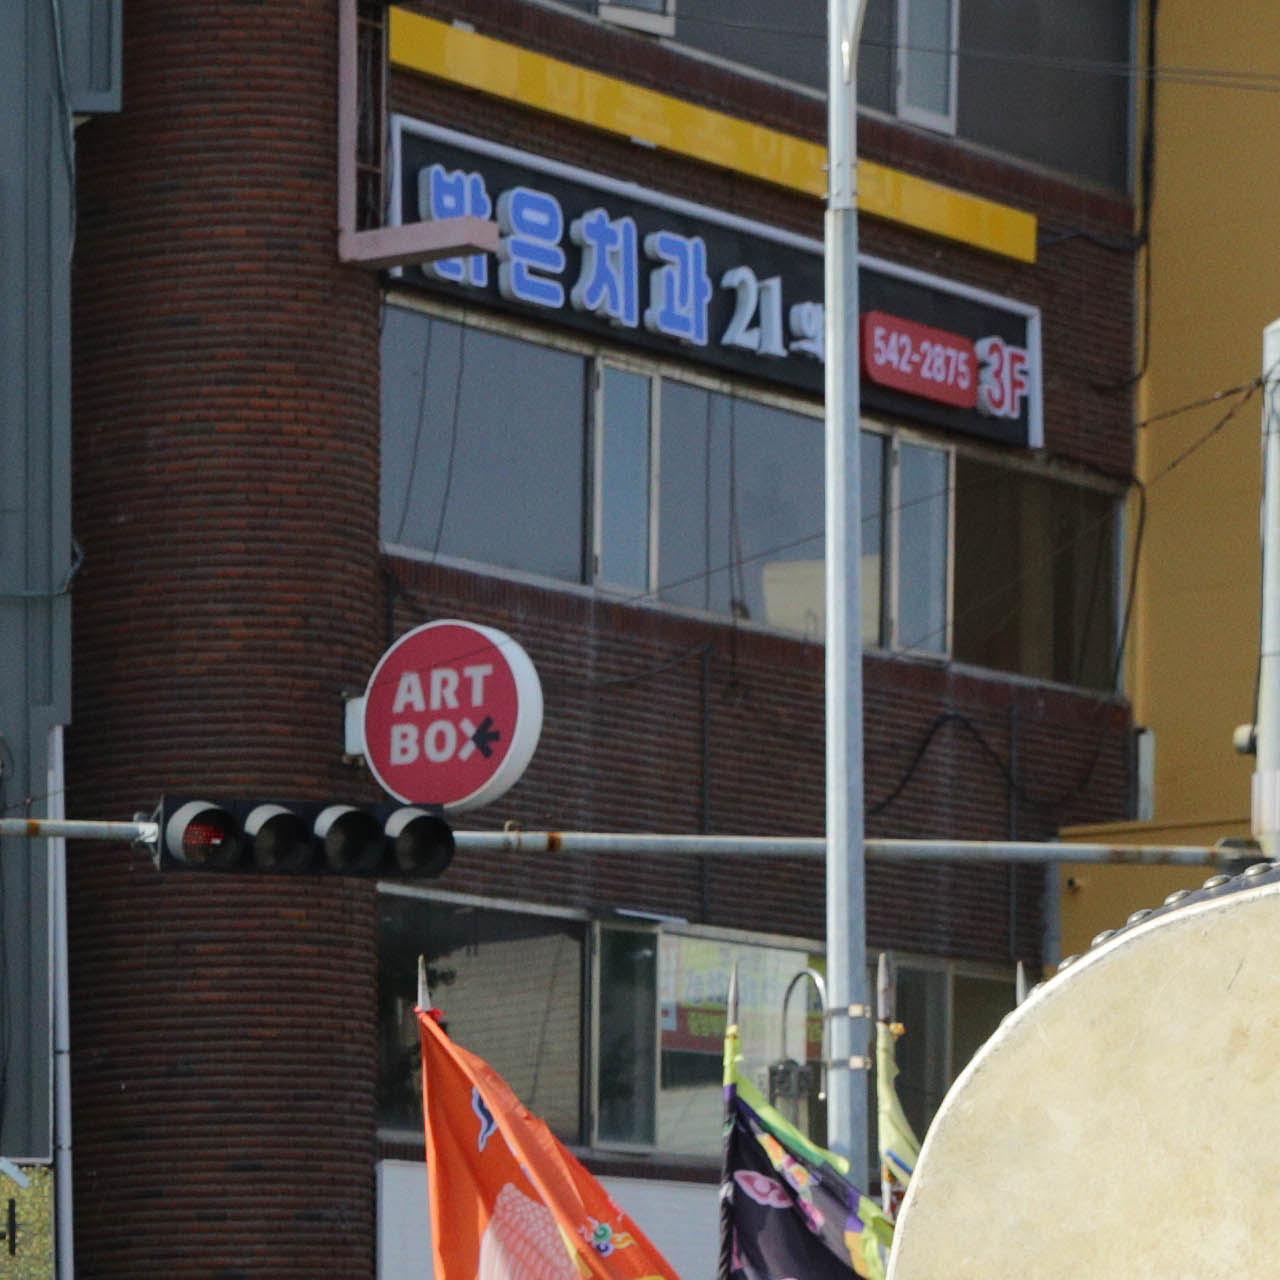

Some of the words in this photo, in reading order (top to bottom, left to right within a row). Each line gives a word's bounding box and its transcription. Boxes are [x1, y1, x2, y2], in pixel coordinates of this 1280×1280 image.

[872, 325, 971, 390] 542-2875
[978, 335, 1029, 419] 3F
[391, 664, 493, 714] ART
[390, 716, 500, 766] BOX
